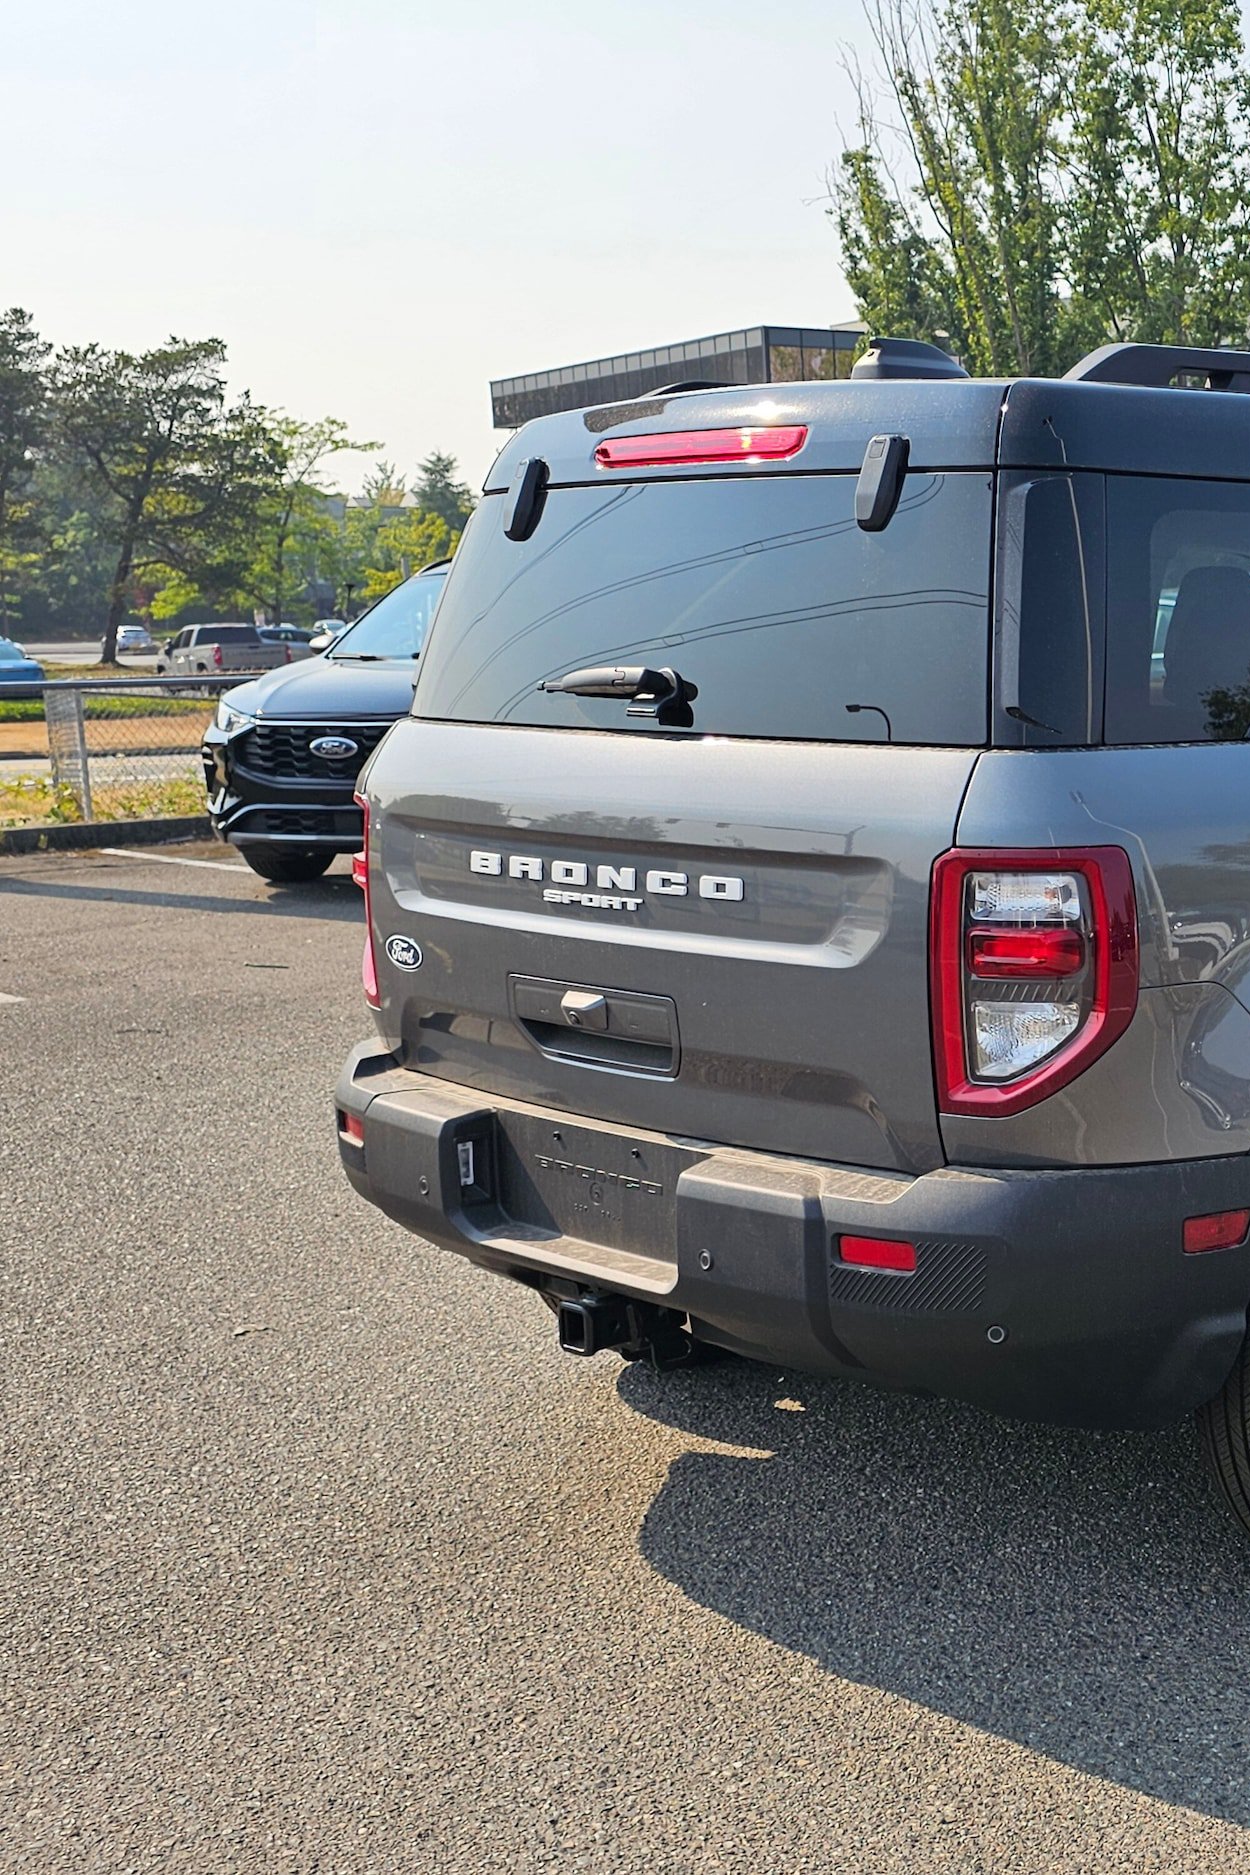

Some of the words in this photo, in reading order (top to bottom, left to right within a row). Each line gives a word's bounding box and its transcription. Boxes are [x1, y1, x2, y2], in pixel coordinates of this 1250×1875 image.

[470, 850, 744, 901] BRONCO
[543, 888, 644, 911] SPORT
[534, 1154, 664, 1196] BRONCO
